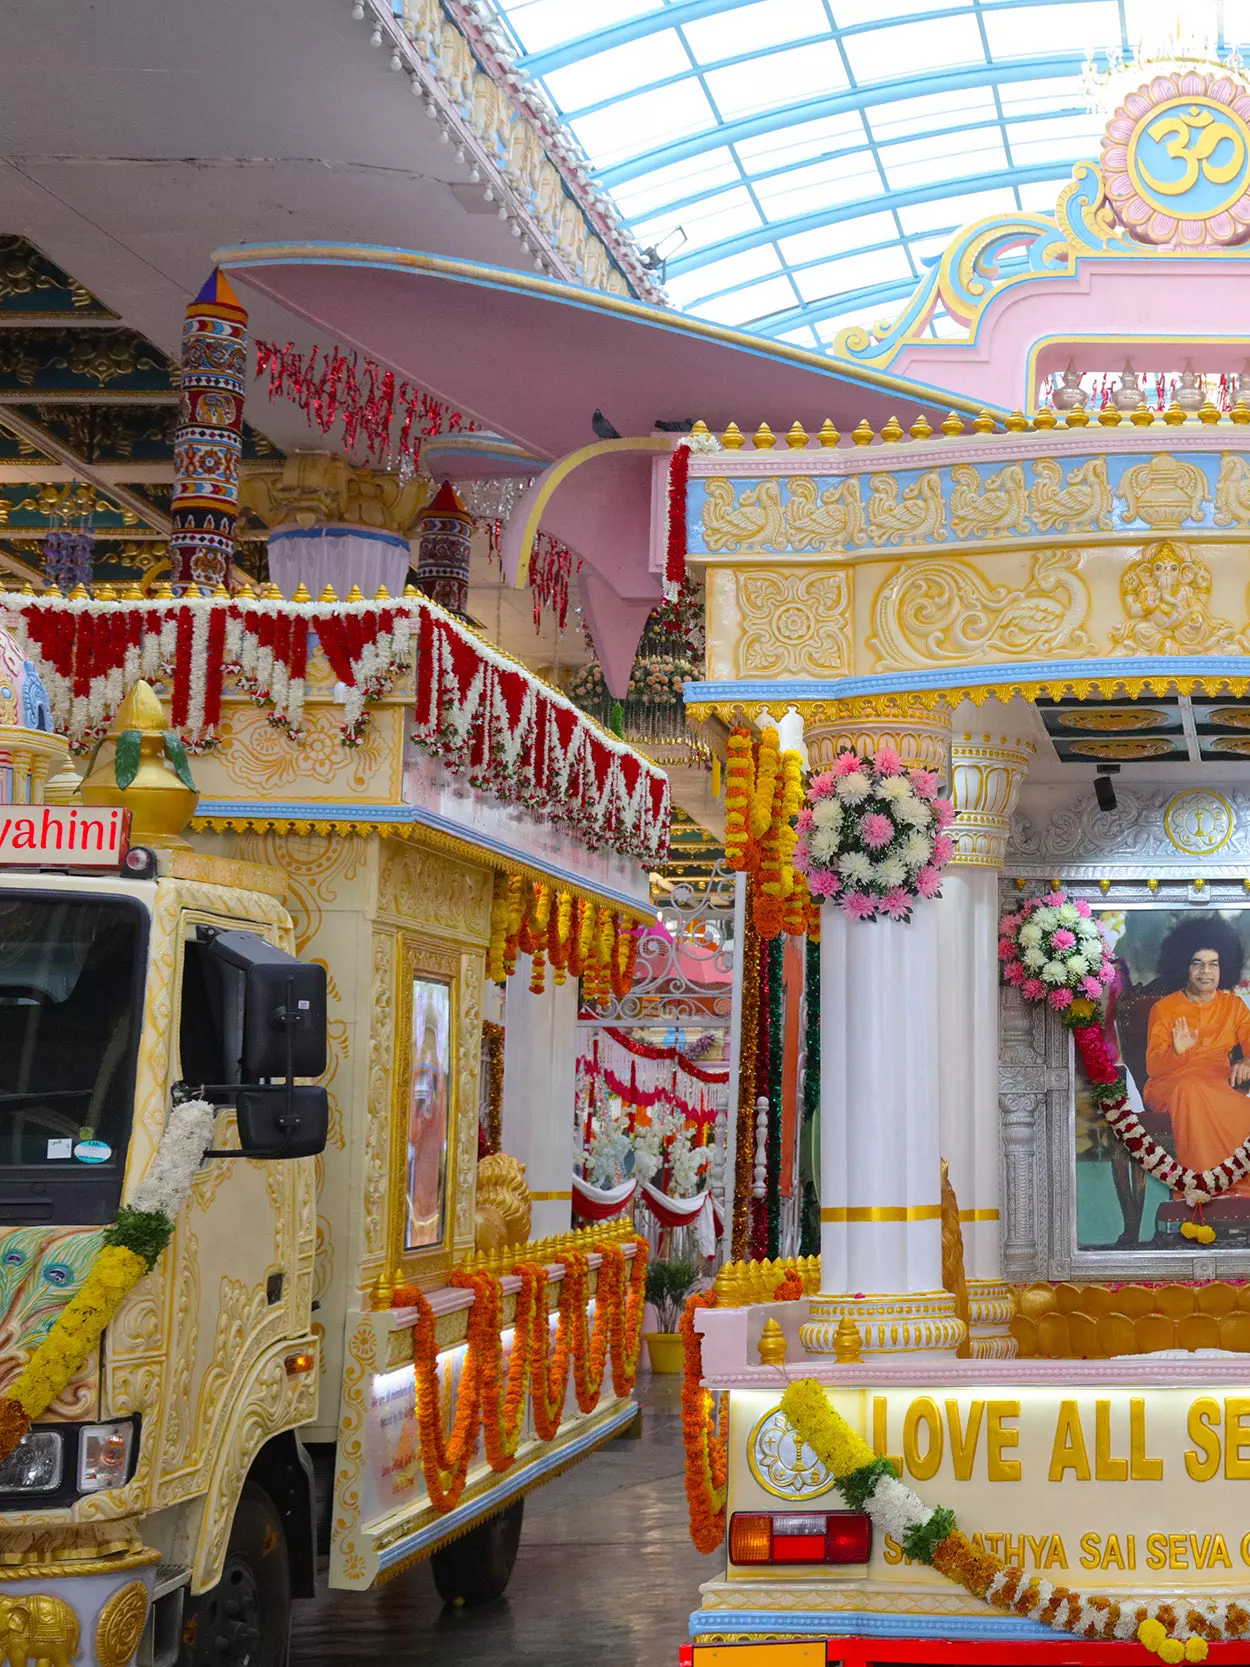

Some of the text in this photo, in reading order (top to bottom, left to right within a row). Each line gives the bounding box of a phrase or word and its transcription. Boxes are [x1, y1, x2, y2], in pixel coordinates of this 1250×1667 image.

[872, 1395, 1022, 1482] LOVE
[1048, 1397, 1164, 1482] ALL
[971, 1531, 1069, 1569] ATHYA
[1080, 1531, 1136, 1570] SAI
[1146, 1531, 1232, 1570] SEVA
